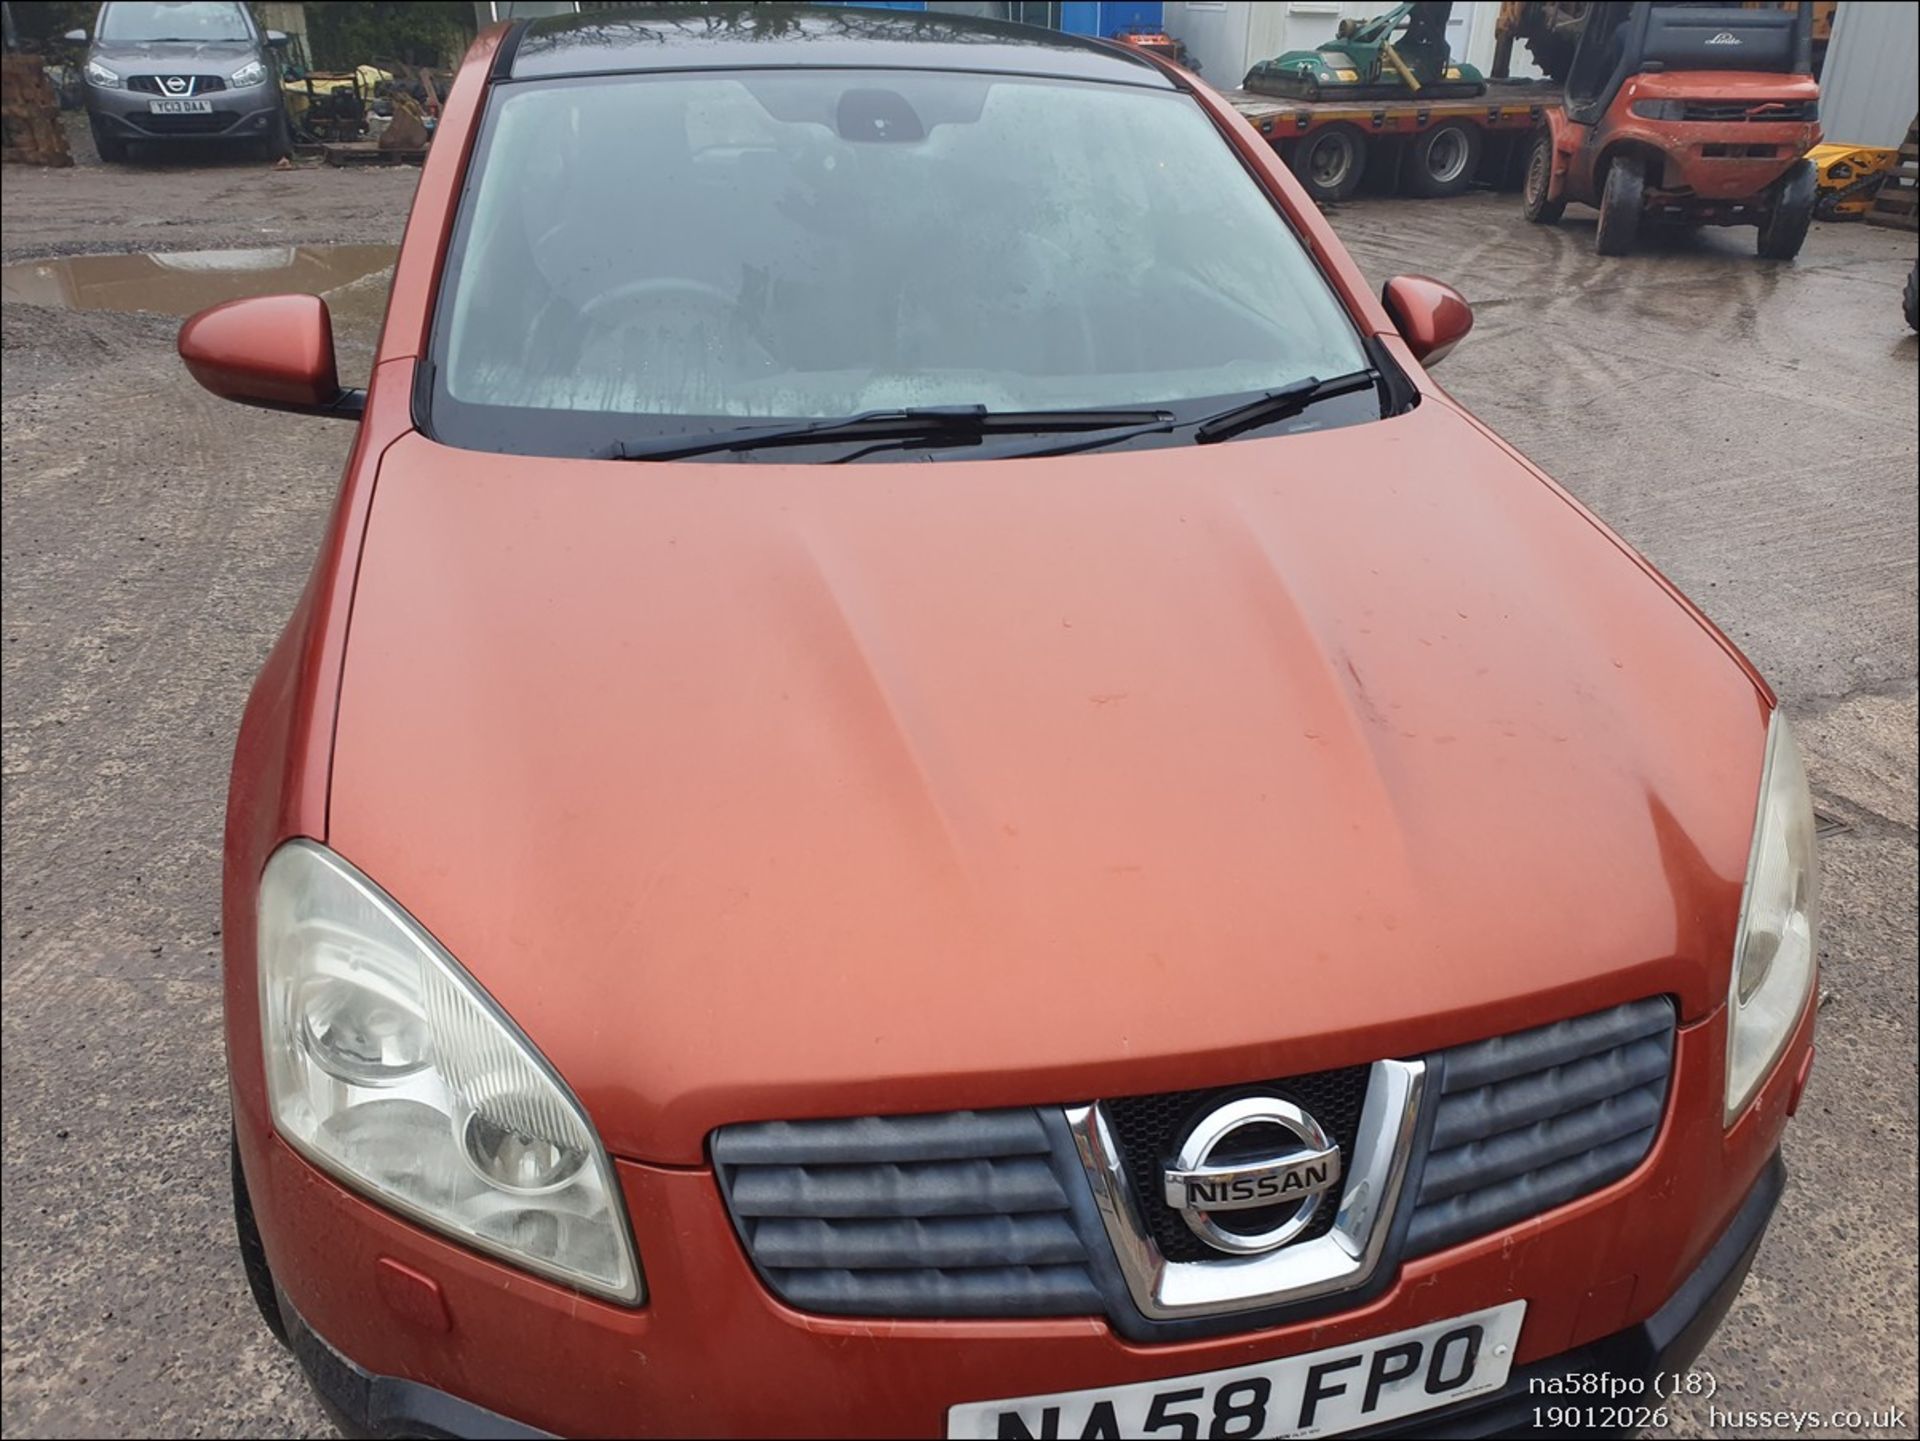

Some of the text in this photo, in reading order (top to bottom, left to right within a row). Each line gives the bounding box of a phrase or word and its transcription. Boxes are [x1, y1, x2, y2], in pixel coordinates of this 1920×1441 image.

[1704, 31, 1743, 45] Linde
[157, 102, 205, 112] YC13 DAA
[1190, 1162, 1328, 1203] NISSAN
